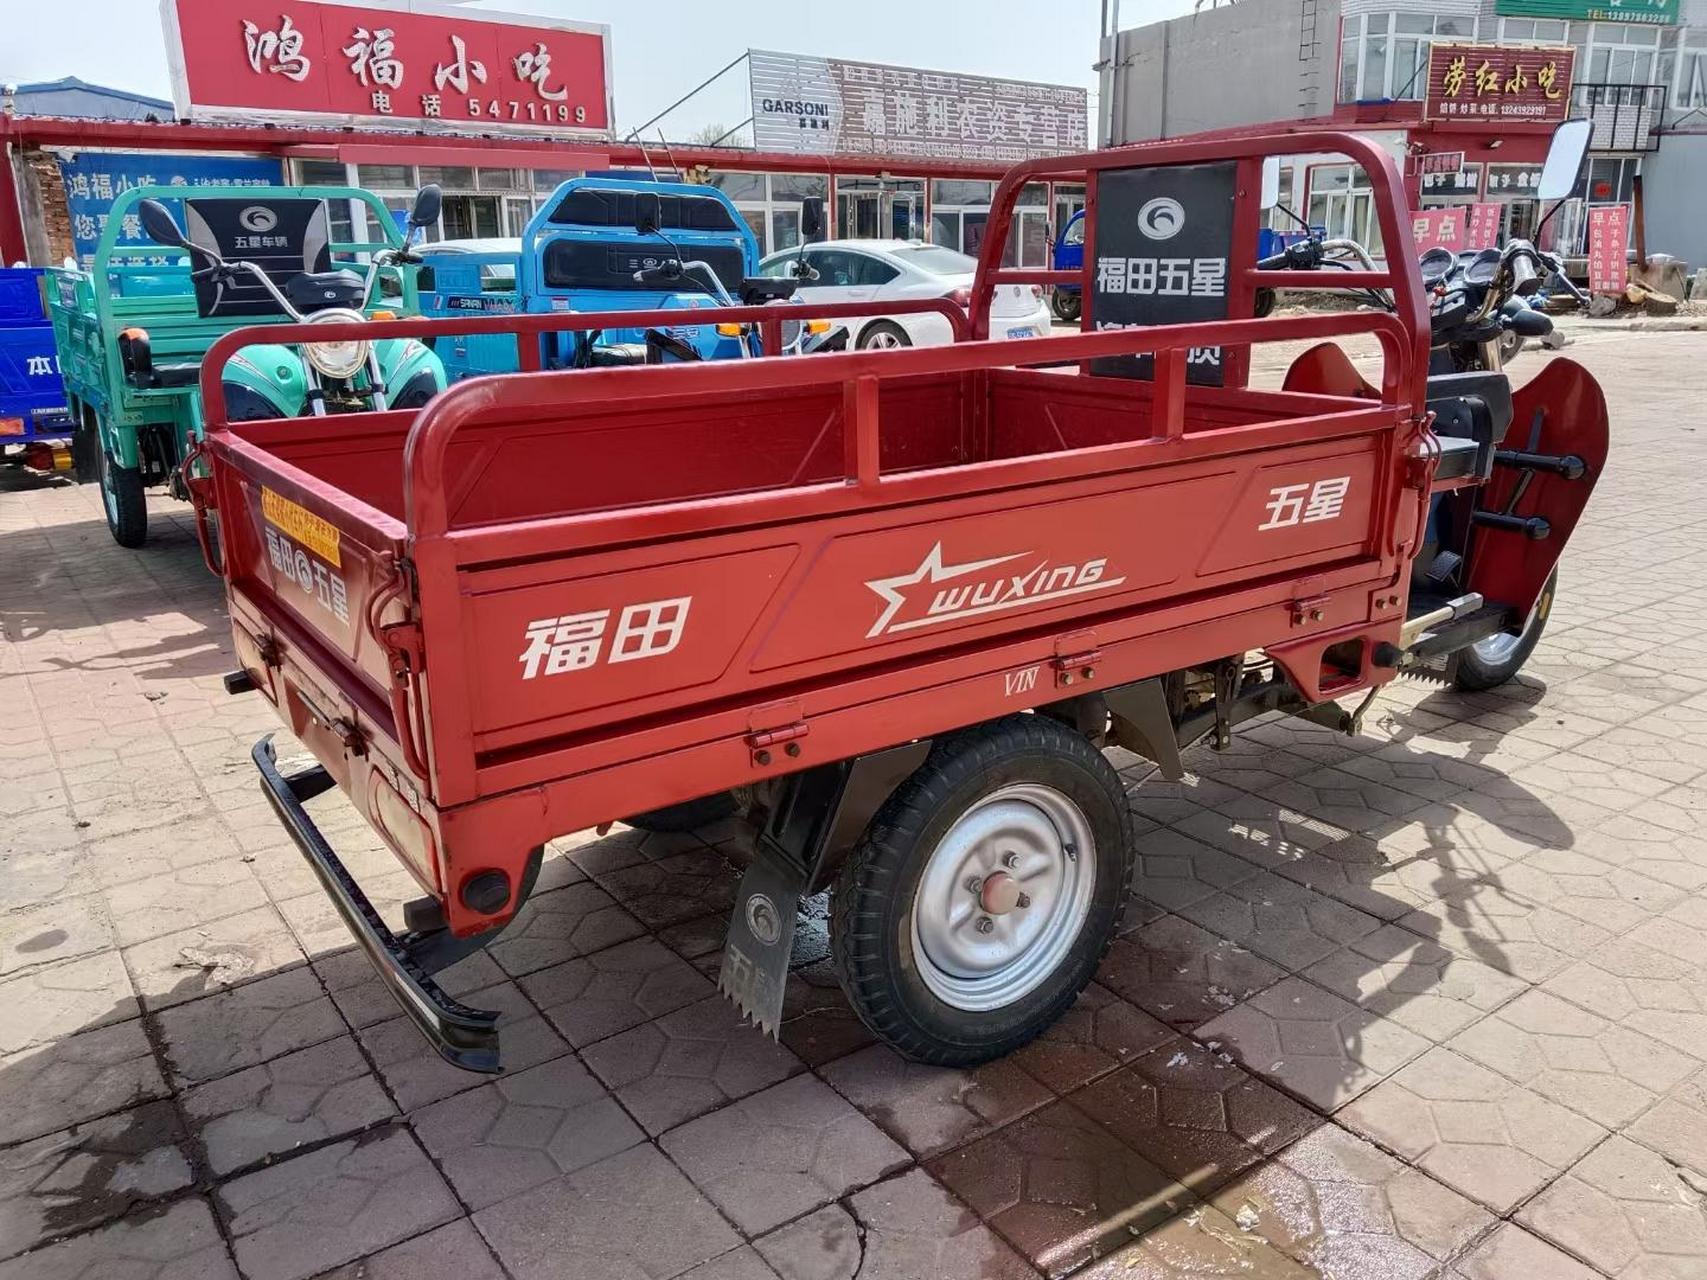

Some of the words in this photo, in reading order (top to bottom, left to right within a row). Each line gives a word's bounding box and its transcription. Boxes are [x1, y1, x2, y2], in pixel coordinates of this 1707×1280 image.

[242, 14, 569, 100] 鸿福小吃
[371, 90, 442, 117] 电话
[468, 98, 586, 123] 5471199
[762, 98, 829, 116] GARSONI
[1413, 215, 1457, 243] 早点
[1592, 211, 1622, 226] 早点
[234, 236, 288, 249] 五星车辆
[1097, 257, 1226, 297] 福田五星
[1258, 476, 1351, 531] 五星
[265, 525, 296, 583] 福田
[312, 559, 350, 629] 五星
[926, 558, 1107, 615] WUXING
[518, 595, 693, 680] 福田
[1005, 666, 1040, 697] VIN
